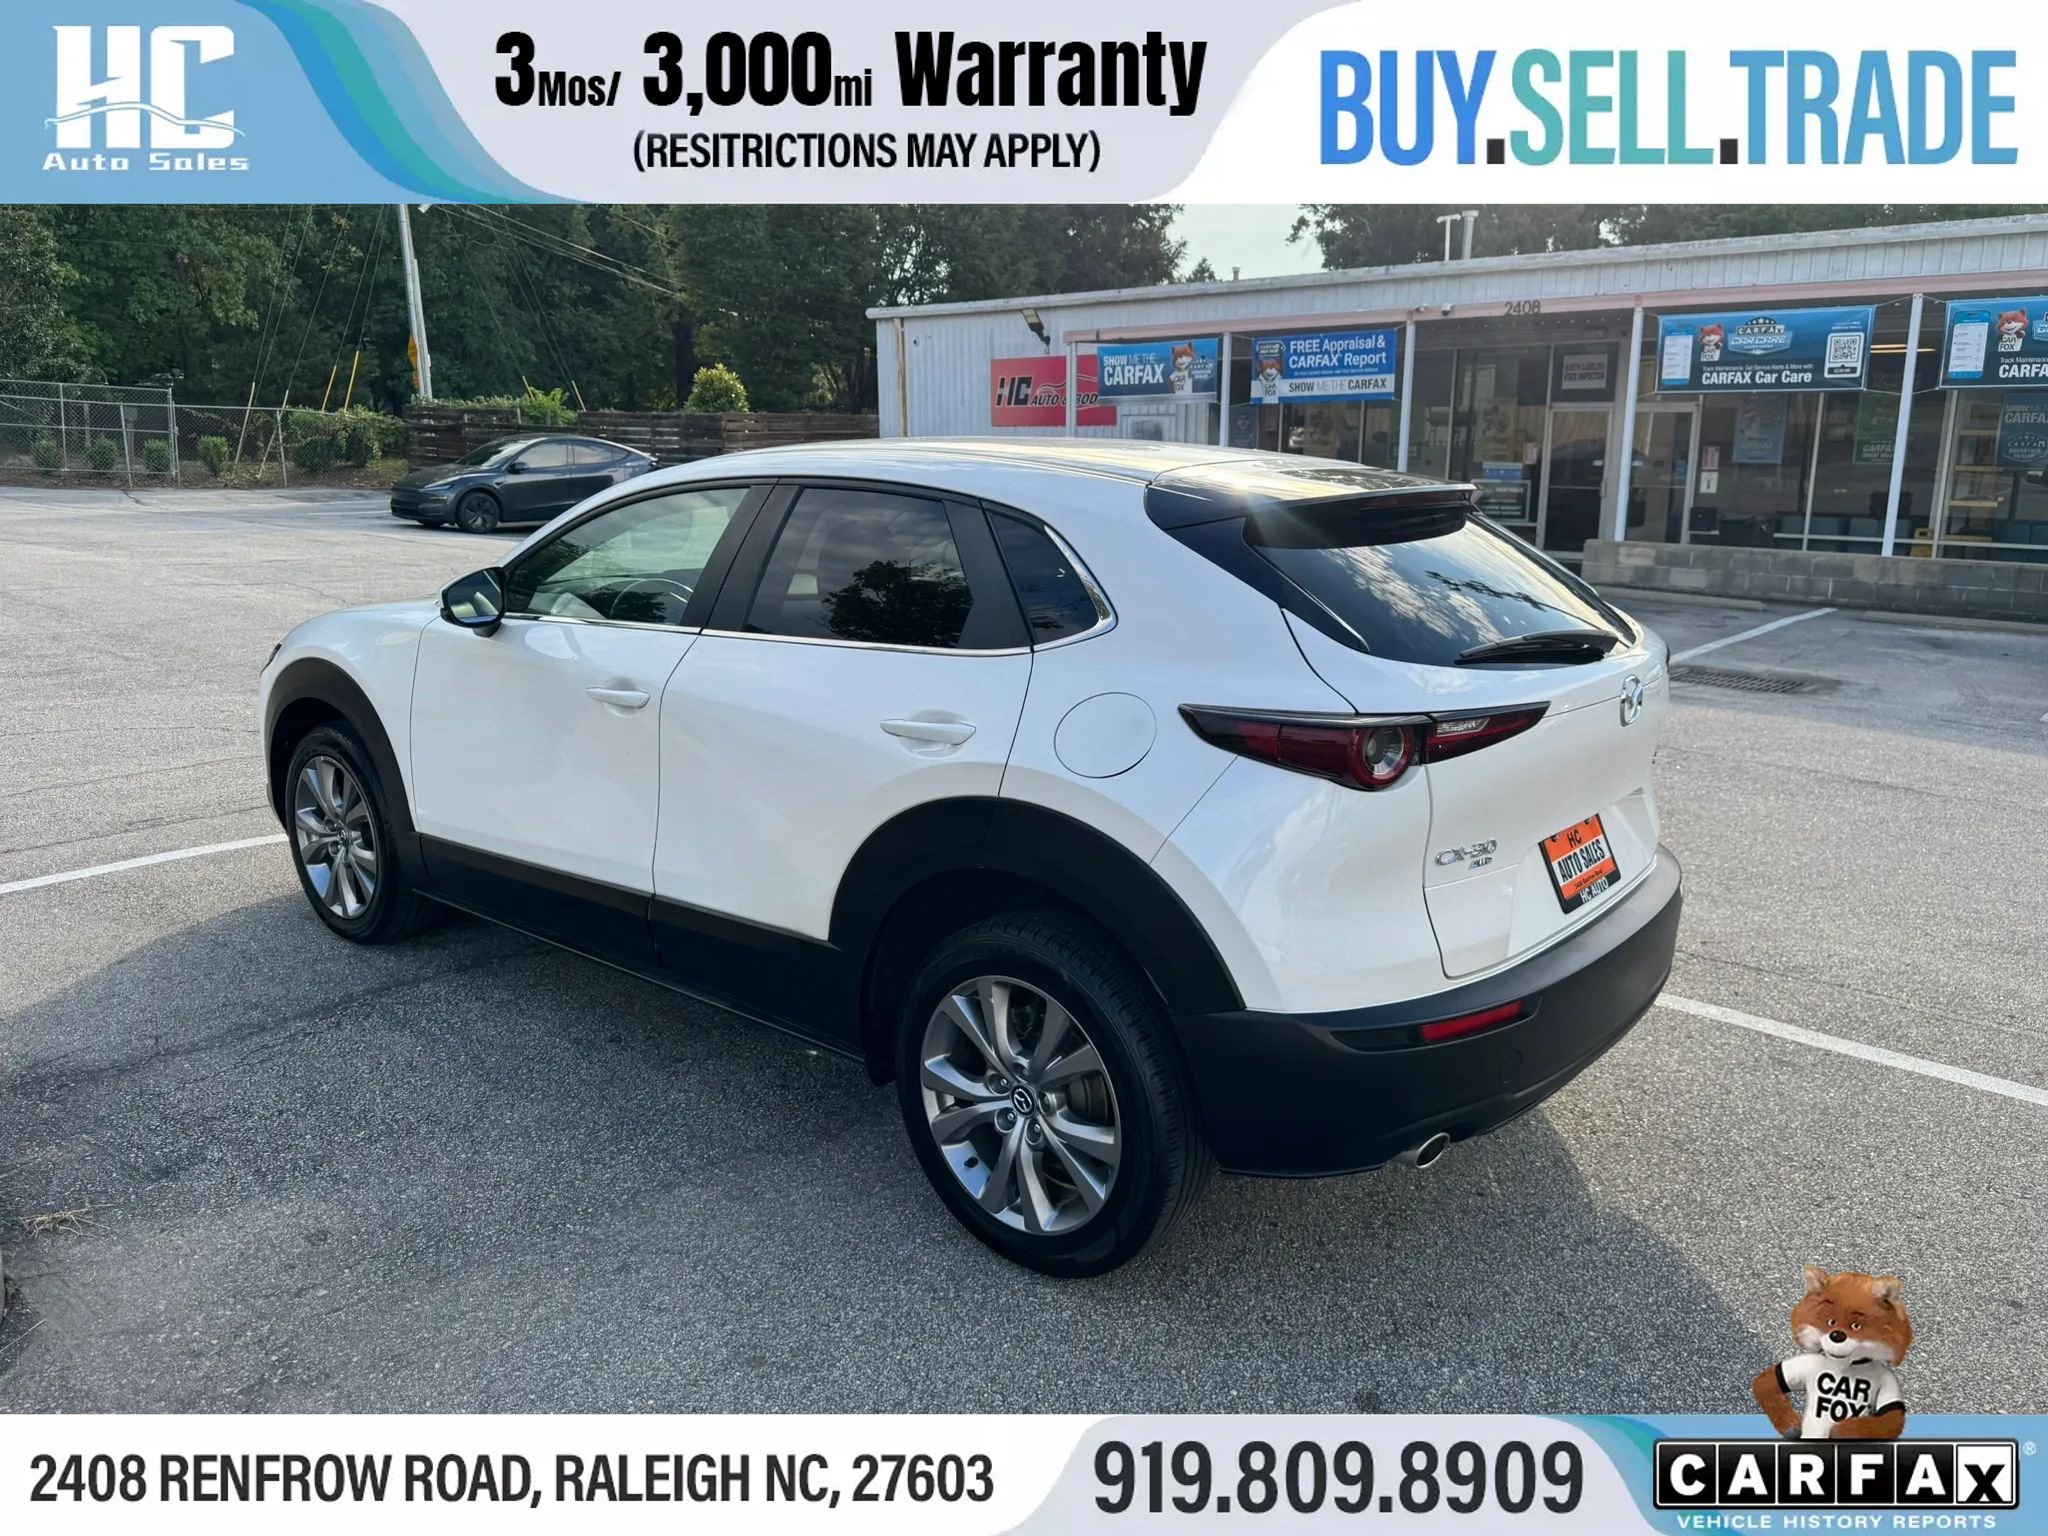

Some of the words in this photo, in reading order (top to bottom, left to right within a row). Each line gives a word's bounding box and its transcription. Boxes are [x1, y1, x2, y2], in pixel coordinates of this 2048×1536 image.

[1504, 300, 1541, 316] 2408
[1290, 340, 1320, 354] FREE
[1322, 335, 1375, 356] Appraisal
[1377, 335, 1386, 348] &
[1103, 354, 1128, 366] SHOW
[1129, 354, 1142, 364] ME
[1142, 353, 1156, 364] THE
[1289, 354, 1339, 369] CARFAX
[1344, 351, 1387, 368] Report
[1103, 364, 1164, 386] CARFAX
[1702, 371, 1752, 385] CARFAX
[1755, 371, 1778, 384] Car
[1781, 370, 1812, 383] Care
[1999, 363, 2048, 378] CARFA
[1288, 382, 1315, 392] SHOW
[1348, 378, 1387, 390] CARFAX
[1031, 393, 1060, 406] AUTO
[1075, 393, 1098, 405] BOD
[2005, 404, 2030, 412] SHOW
[2004, 412, 2048, 424] CARFA
[1567, 829, 1582, 848] HC
[1435, 839, 1497, 865] CX-30
[1557, 854, 1583, 883] AUTO
[1582, 839, 1606, 869] SALES
[1580, 887, 1592, 904] HC
[1591, 876, 1609, 898] AUTO
